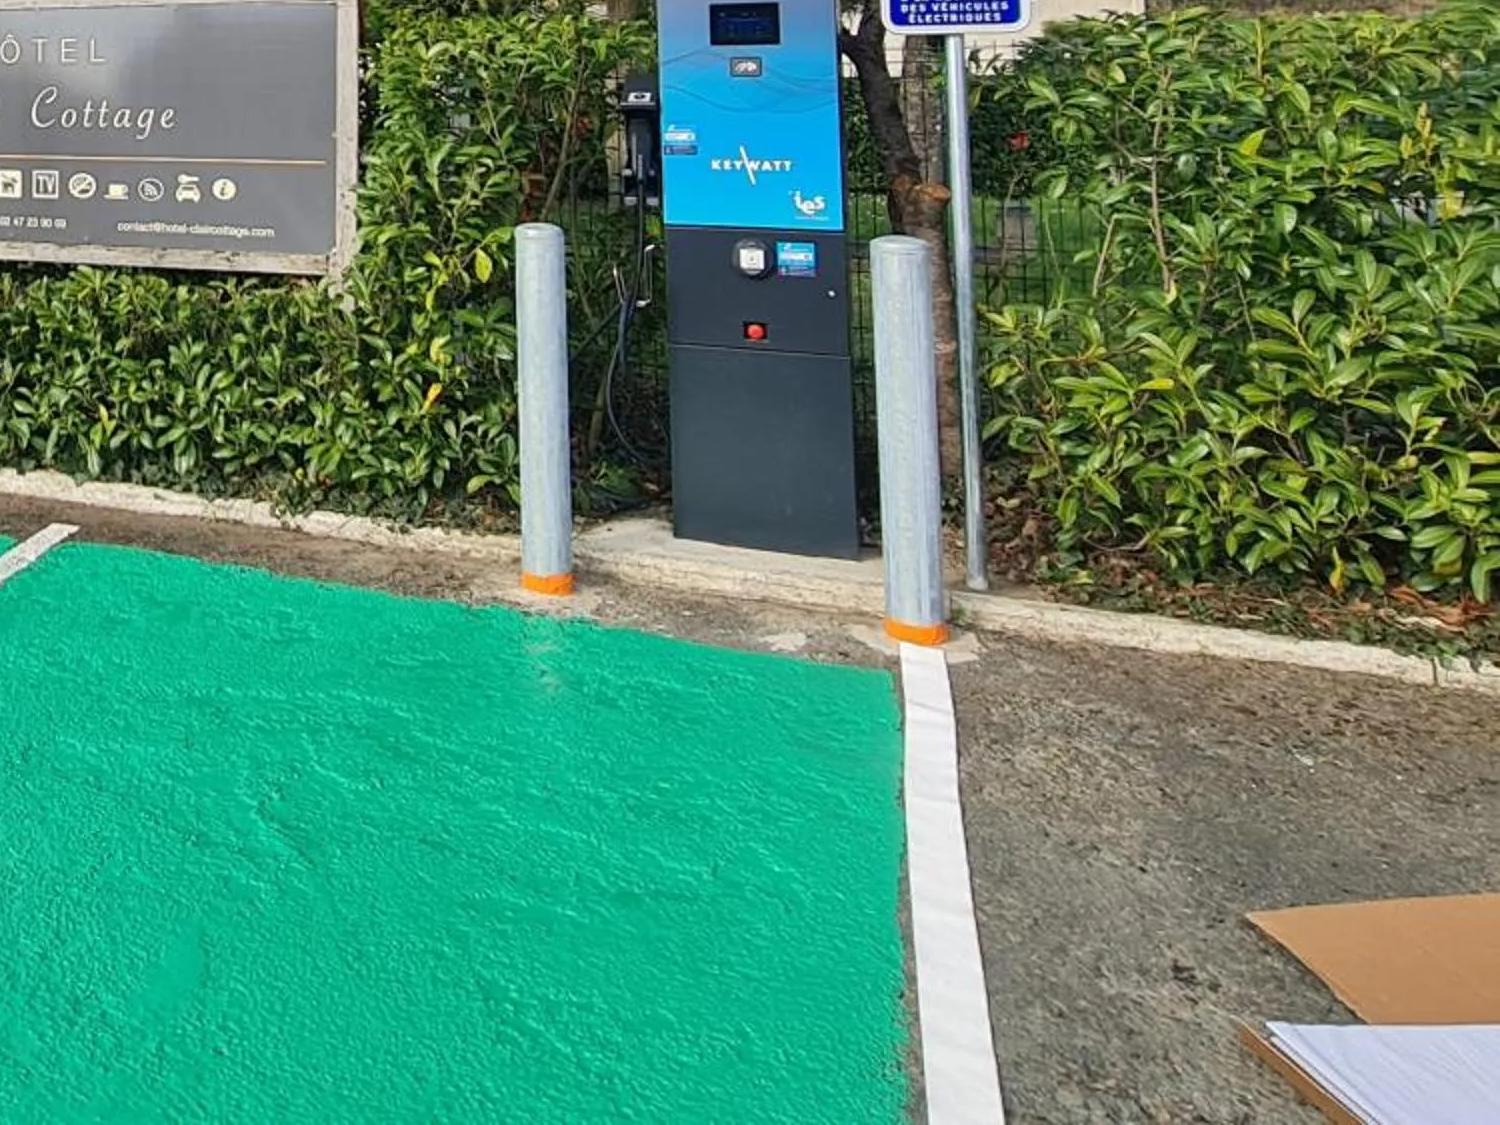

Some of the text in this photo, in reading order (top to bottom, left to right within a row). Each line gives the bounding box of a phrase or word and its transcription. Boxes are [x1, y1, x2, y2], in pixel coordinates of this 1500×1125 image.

[901, 1, 1009, 14] DES VÉHICULES
[30, 85, 175, 141] Cottage
[710, 158, 792, 173] KEYWATT
[36, 174, 55, 194] TV
